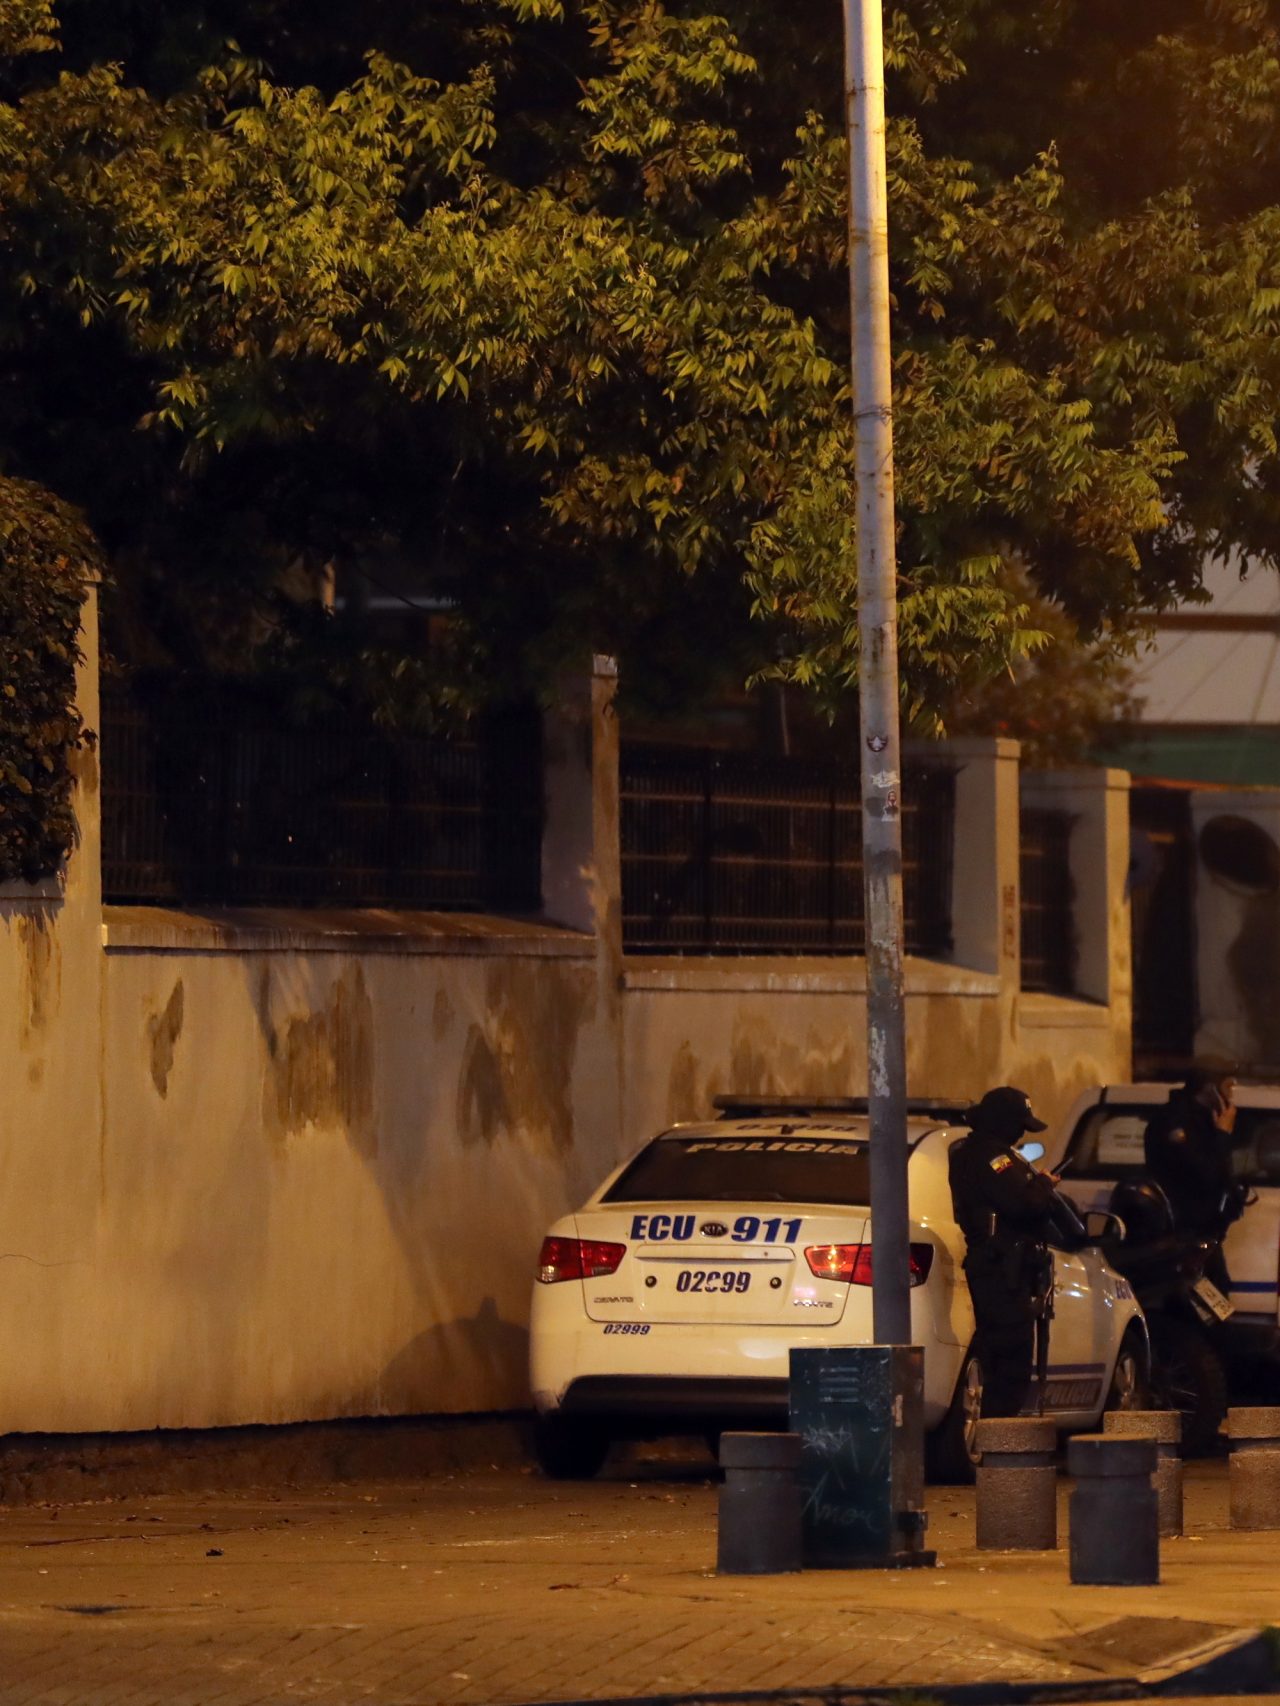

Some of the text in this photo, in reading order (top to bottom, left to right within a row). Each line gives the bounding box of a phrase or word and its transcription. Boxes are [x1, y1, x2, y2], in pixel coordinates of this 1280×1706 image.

[686, 1141, 860, 1155] POLICIA
[630, 1215, 803, 1244] ECU 911
[603, 1323, 651, 1335] 02999
